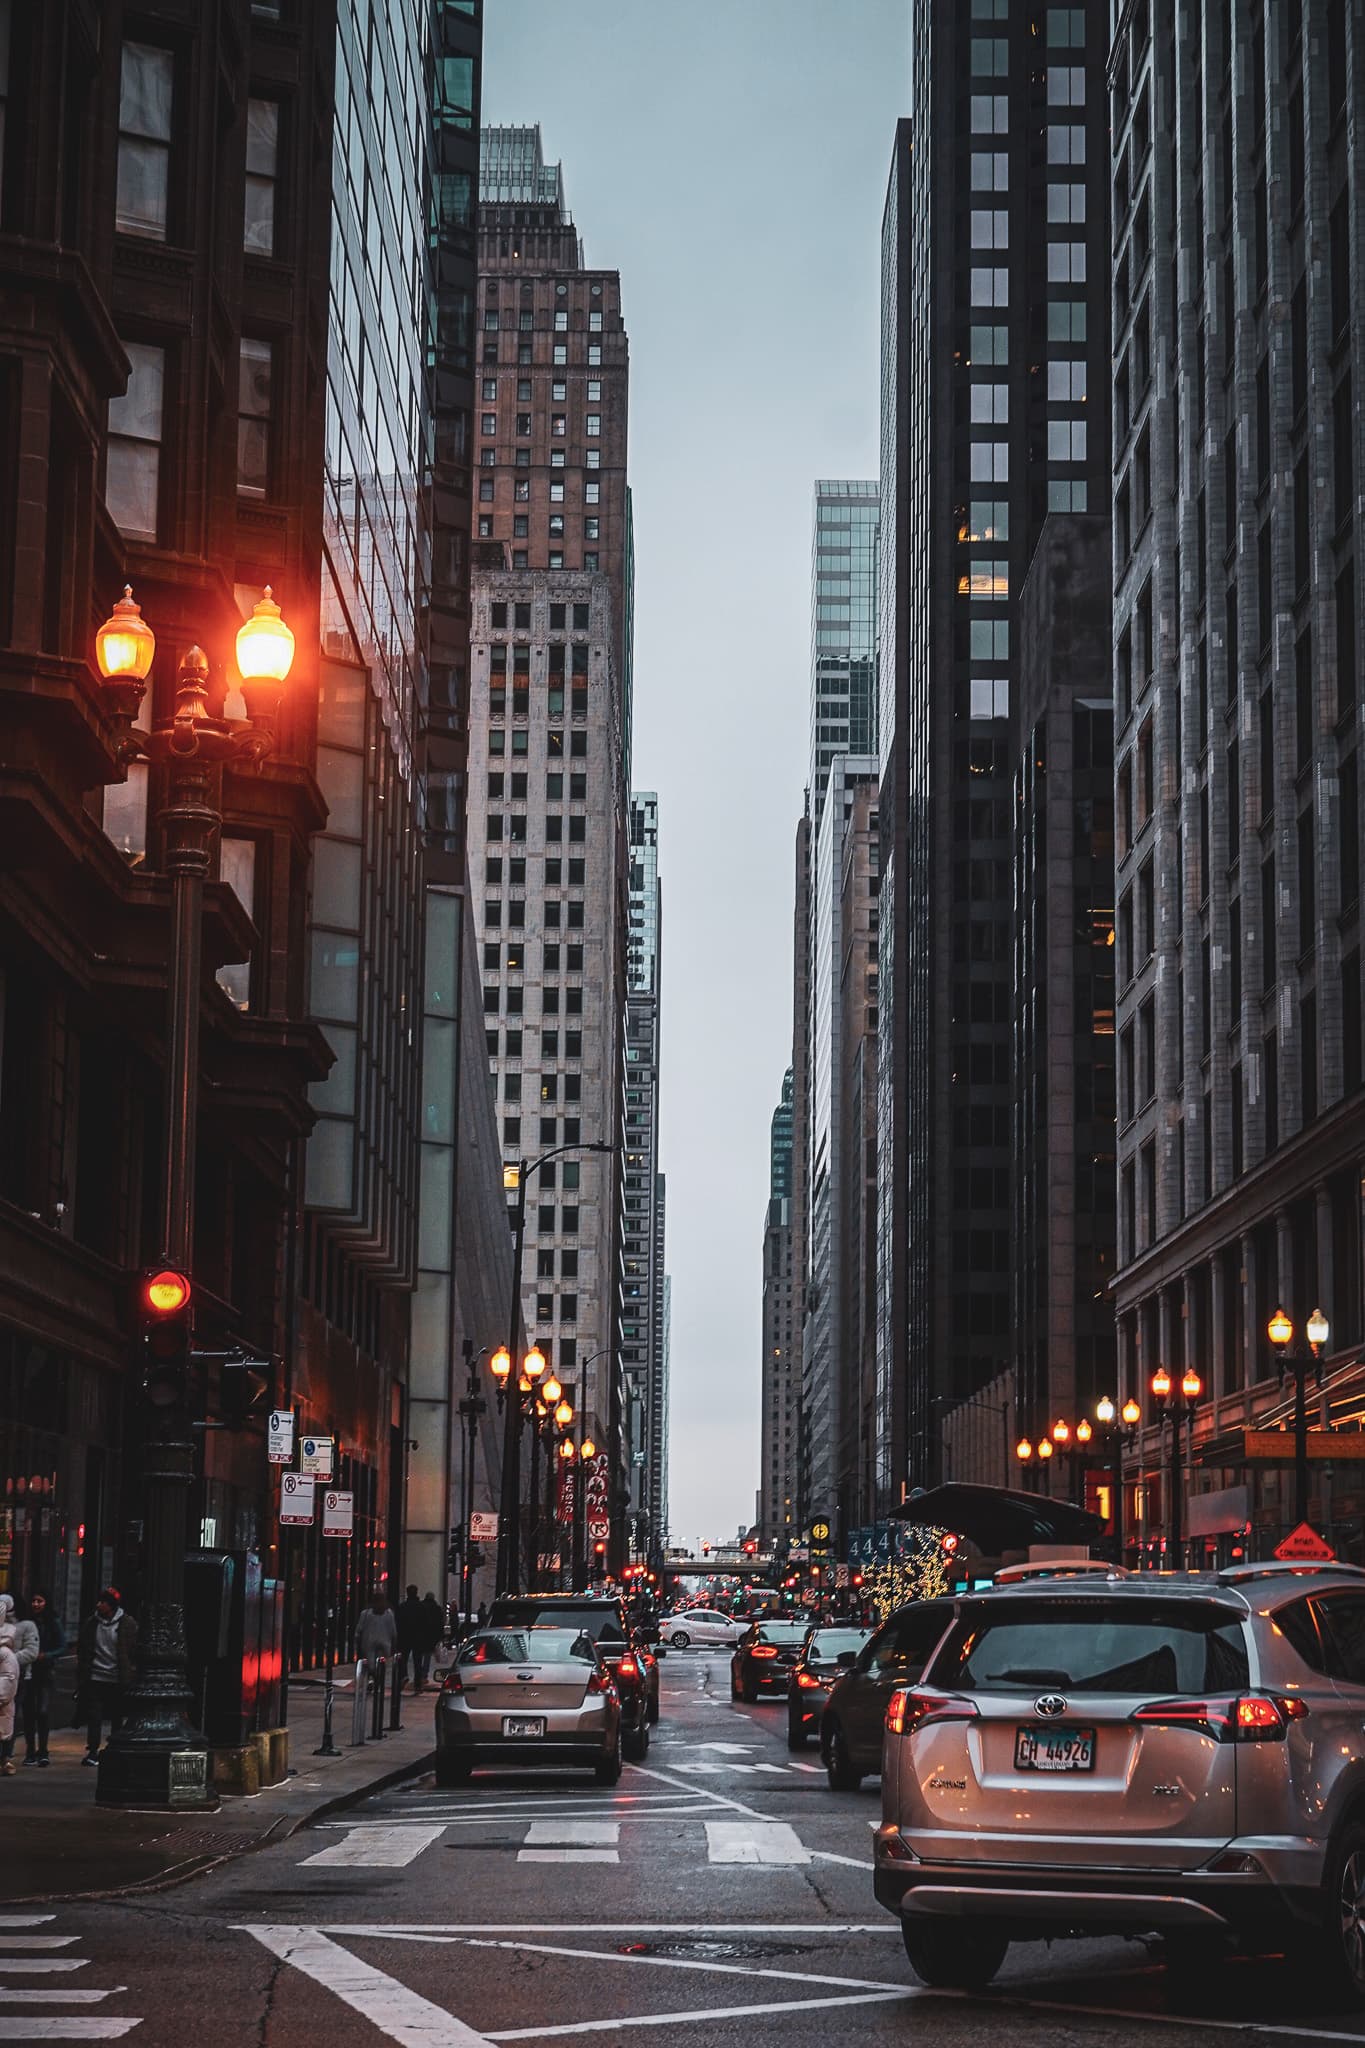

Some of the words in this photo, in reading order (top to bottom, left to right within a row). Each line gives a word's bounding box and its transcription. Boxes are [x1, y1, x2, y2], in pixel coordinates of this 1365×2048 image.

[565, 1475, 574, 1513] MUSIC
[850, 1541, 859, 1556] 4
[862, 1538, 873, 1555] 4
[878, 1532, 889, 1550] 4
[1020, 1740, 1038, 1760] CH
[1046, 1740, 1090, 1761] 44926
